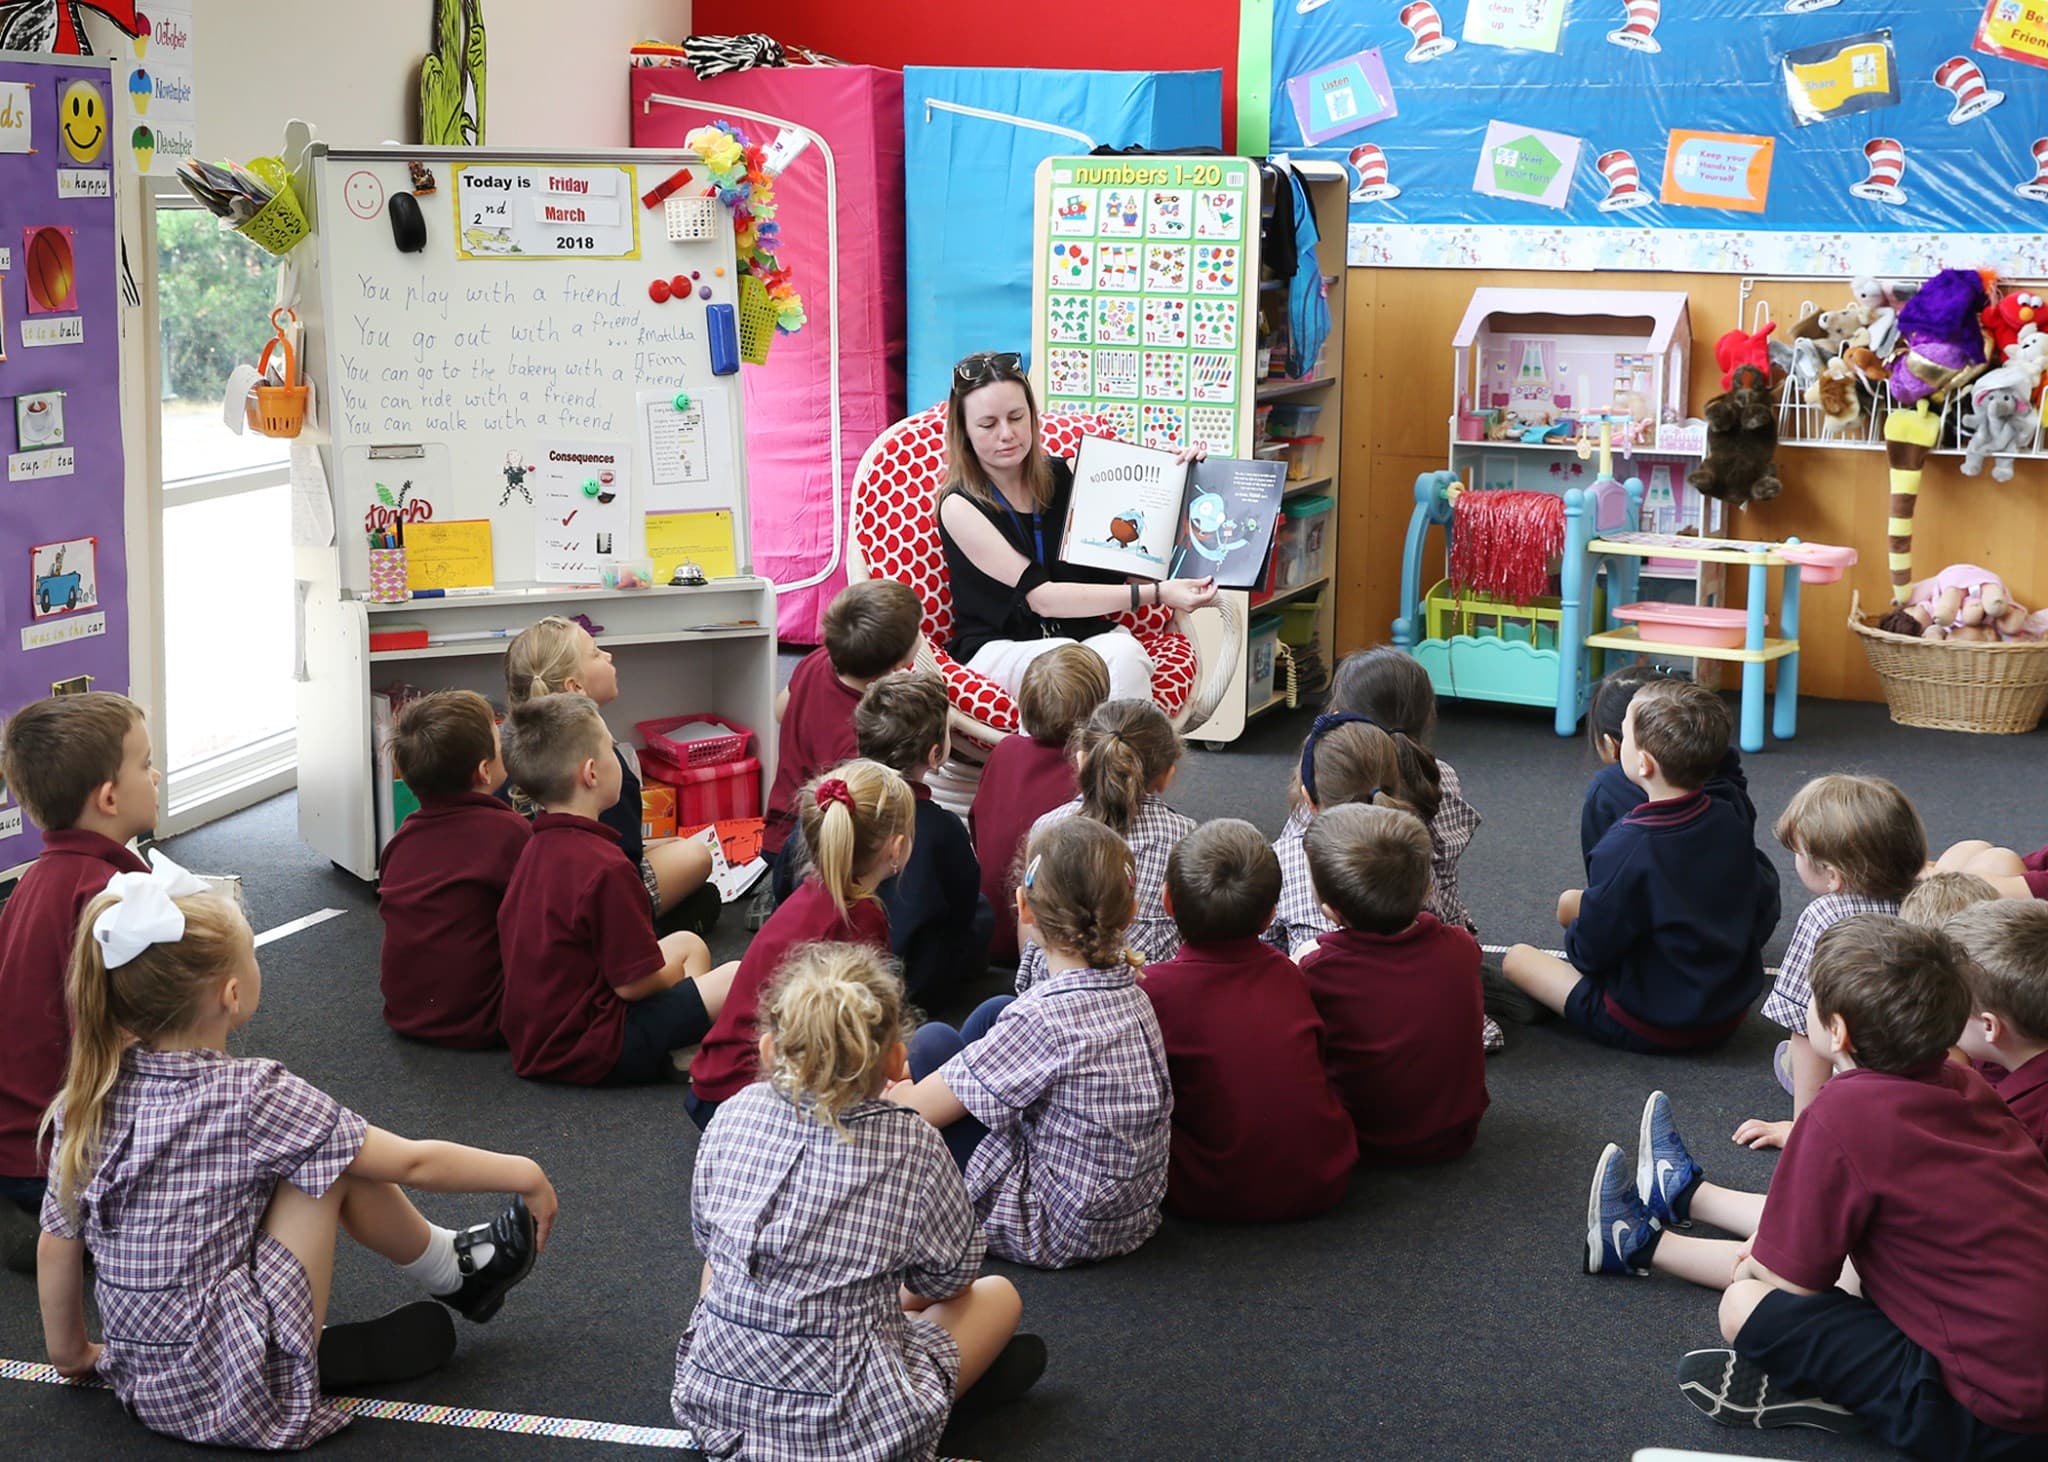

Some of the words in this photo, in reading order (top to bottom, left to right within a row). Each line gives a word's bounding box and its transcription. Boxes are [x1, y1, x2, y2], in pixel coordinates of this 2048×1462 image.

[2025, 9, 2044, 24] Be
[155, 17, 187, 50] October
[1321, 76, 1349, 91] Listen
[1806, 80, 1836, 90] Share
[155, 76, 191, 104] November
[156, 129, 192, 158] December
[1700, 150, 1722, 160] Keep
[1075, 163, 1168, 185] numbers
[1175, 164, 1223, 186] 1-20
[74, 172, 107, 195] happy
[463, 175, 512, 191] Today
[517, 175, 531, 188] is
[549, 176, 589, 194] Friday
[545, 206, 586, 222] March
[1055, 221, 1059, 231] 1
[1101, 222, 1108, 233] 2
[1150, 223, 1157, 234] 3
[1198, 224, 1206, 235] 4
[556, 237, 594, 250] 2018
[1052, 275, 1058, 286] 5
[1099, 276, 1106, 287] 6
[1147, 278, 1154, 289] 7
[1196, 279, 1203, 290] 8
[358, 273, 391, 301] You
[405, 274, 449, 320] play
[466, 280, 516, 303] with
[532, 287, 546, 302] a
[59, 320, 81, 337] ball
[1051, 328, 1058, 339] 9
[354, 314, 390, 348] You
[412, 330, 436, 363] go
[454, 323, 491, 347] out
[511, 316, 559, 344] with
[572, 322, 583, 337] a
[1098, 330, 1111, 341] 10
[1146, 332, 1156, 342] 11
[1194, 333, 1206, 345] 12
[648, 352, 687, 368] Finn
[341, 353, 369, 382] You
[381, 367, 408, 382] can
[417, 367, 434, 390] go
[443, 359, 461, 379] to
[472, 358, 495, 381] the
[507, 353, 557, 388] bakery
[565, 358, 603, 377] with
[612, 368, 624, 381] a
[1051, 380, 1062, 392] 13
[1098, 382, 1110, 393] 14
[1145, 385, 1157, 396] 15
[341, 386, 368, 410] You
[380, 395, 412, 410] can
[422, 388, 452, 407] ride
[465, 383, 507, 407] with
[520, 391, 529, 401] a
[1193, 387, 1205, 398] 16
[344, 412, 372, 434] You
[384, 417, 412, 431] can
[426, 410, 467, 431] walk
[484, 407, 526, 430] with
[537, 413, 548, 425] a
[1145, 438, 1157, 449] 19
[549, 450, 615, 465] Consequences
[20, 460, 39, 476] cup
[58, 455, 73, 467] tea
[87, 623, 104, 634] car
